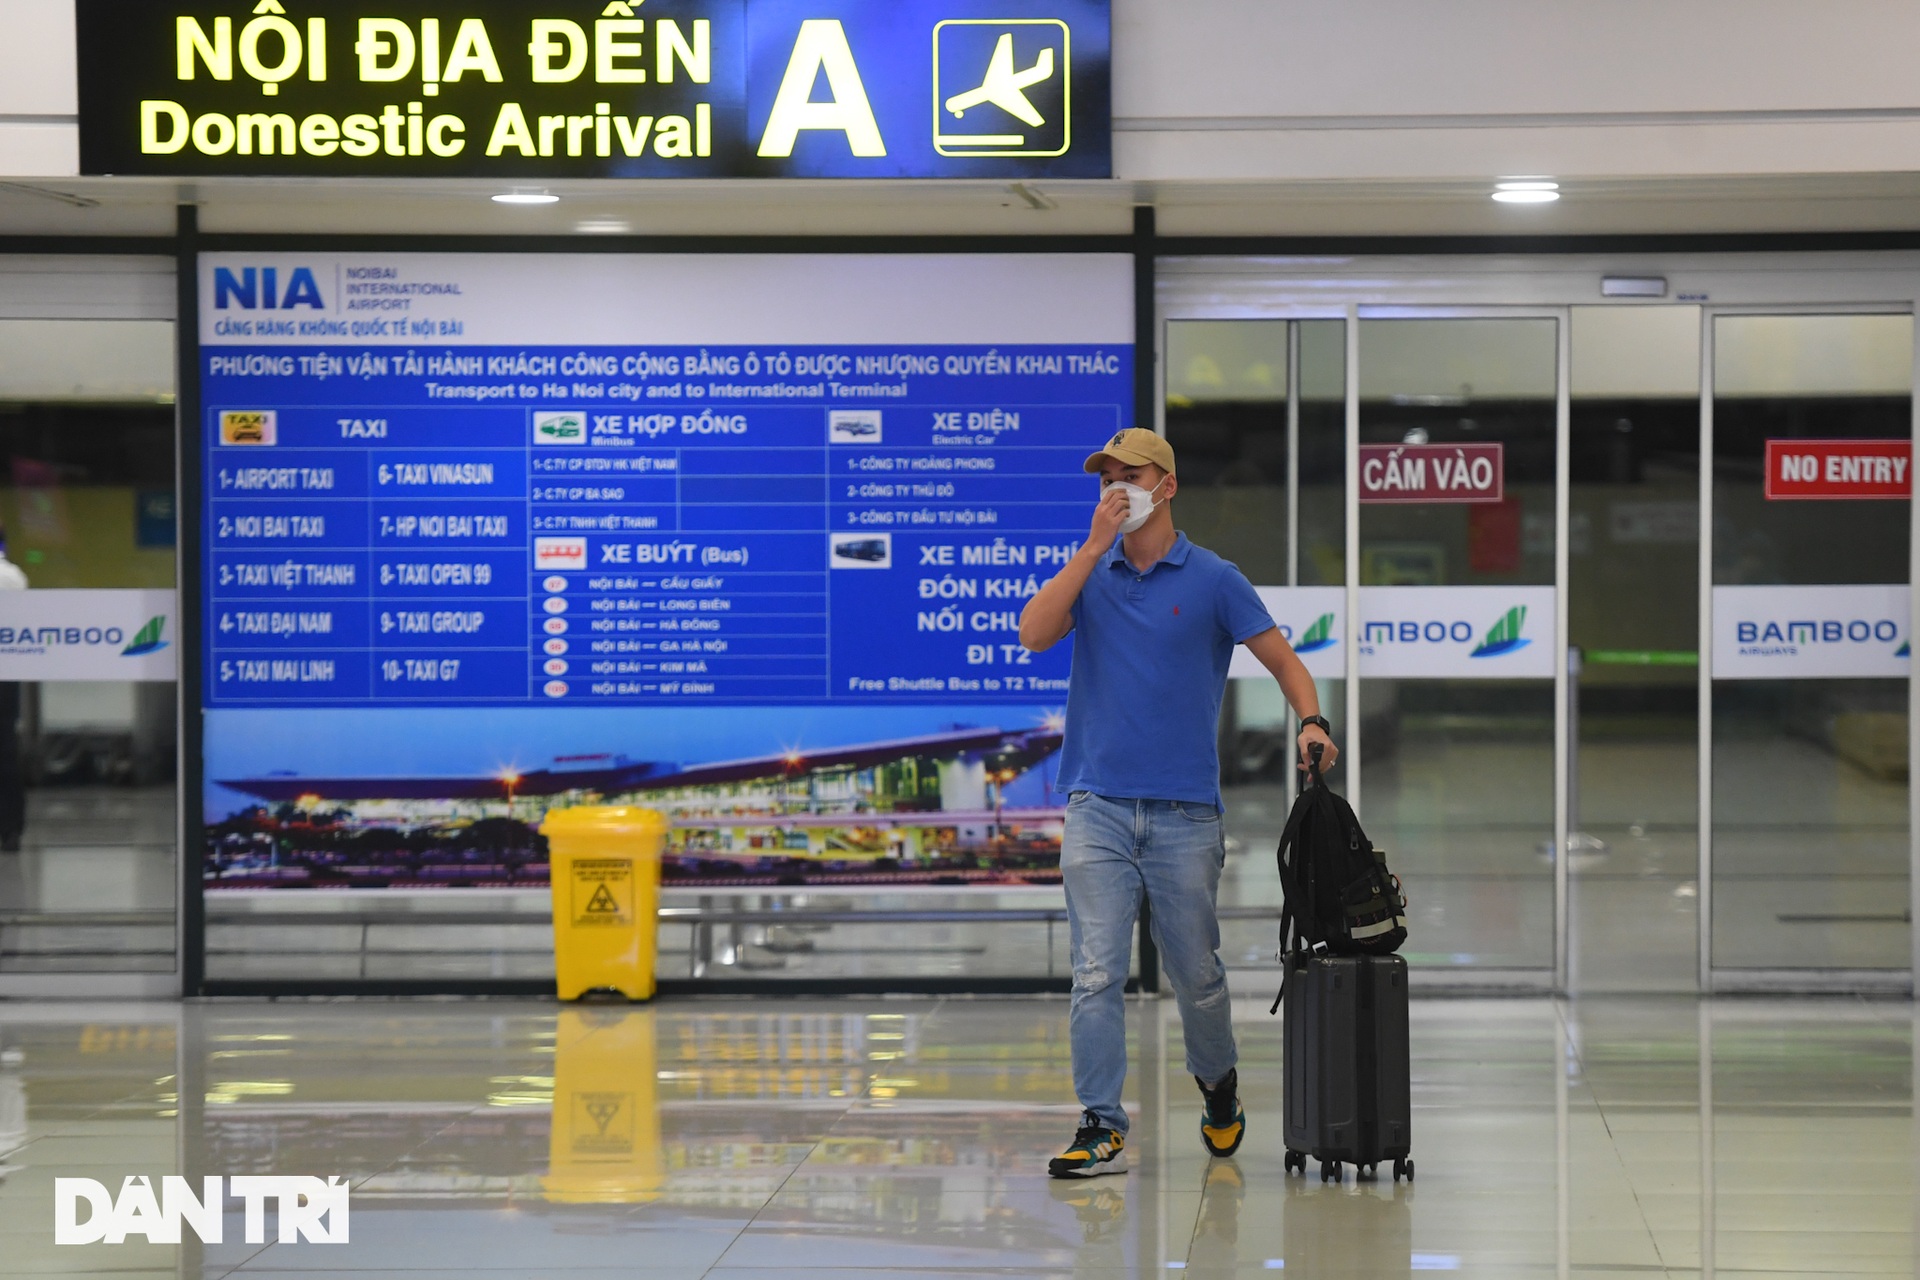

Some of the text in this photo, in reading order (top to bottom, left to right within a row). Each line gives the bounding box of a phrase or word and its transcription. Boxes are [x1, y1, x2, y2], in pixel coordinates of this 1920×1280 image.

[175, 0, 711, 97] NỘI ĐỊA ĐẾN
[756, 19, 887, 158] A
[141, 100, 711, 158] Domestic Arrival
[347, 268, 397, 279] NOIBAI
[213, 267, 325, 310] NIA
[347, 283, 462, 295] INTERNATIONAL
[347, 298, 411, 311] AIRPORT
[210, 353, 294, 376] PHƯƠNG
[298, 351, 342, 379] TIỆN
[347, 351, 386, 380] VẬN
[428, 350, 484, 376] HÀNH
[488, 350, 556, 376] KHÁCH
[561, 350, 618, 376] CÔNG
[622, 350, 679, 381] CỘNG
[744, 350, 761, 376] Ô
[765, 350, 790, 376] TÔ
[795, 353, 850, 380] ĐƯỢC
[856, 353, 938, 380] NHƯỢNG
[944, 348, 1010, 377] QUYỀN
[1016, 355, 1062, 375] KHAI
[1067, 350, 1119, 375] THÁC
[425, 382, 907, 401] Transport to Ha Noi city and to International Terminal
[228, 414, 268, 425] TAXI
[337, 420, 387, 438] TAXI
[593, 408, 747, 439] XE HỢP ĐỒNG
[933, 408, 1019, 435] XE ĐIỆN
[933, 435, 995, 446] Electric Car
[234, 469, 296, 489] AIRPORT
[302, 469, 333, 489] TAXI
[395, 465, 428, 485] TAXI
[430, 465, 493, 485] VINASUN
[1363, 448, 1494, 491] CẤM VÀO
[1781, 455, 1908, 483] NO ENTRY
[235, 517, 261, 537] NOI
[264, 517, 289, 537] BAI
[292, 517, 324, 537] TAXI
[396, 517, 417, 537] HP
[419, 517, 444, 537] NOI
[448, 517, 473, 537] BAI
[475, 517, 507, 537] TAXI
[602, 539, 748, 566] XE BUÝT (Bus)
[920, 546, 955, 565] XE
[962, 537, 1026, 565] MIỄN
[236, 565, 268, 585] TAXI
[270, 559, 302, 591] VIỆT
[305, 565, 355, 585] THANH
[397, 565, 429, 585] TAXI
[432, 565, 472, 585] OPEN
[474, 565, 491, 585] 99
[919, 574, 976, 598] ĐÓN
[236, 613, 268, 633] TAXI
[299, 613, 332, 633] NAM
[397, 613, 430, 633] TAXI
[433, 613, 484, 633] GROUP
[918, 604, 963, 631] NỐI
[0, 627, 123, 645] BAMBOO
[1737, 620, 1897, 645] BAMBOO
[967, 645, 1031, 664] ĐI T2
[1739, 646, 1798, 657] AIRWAYS
[237, 661, 268, 681] TAXI
[272, 661, 298, 681] MAI
[301, 661, 334, 681] LINH
[405, 661, 437, 681] TAXI
[440, 661, 459, 681] G7
[849, 677, 885, 690] Free
[888, 677, 944, 690] Shuttle
[949, 677, 980, 690] Bus
[984, 677, 999, 690] to
[1006, 677, 1024, 690] T2
